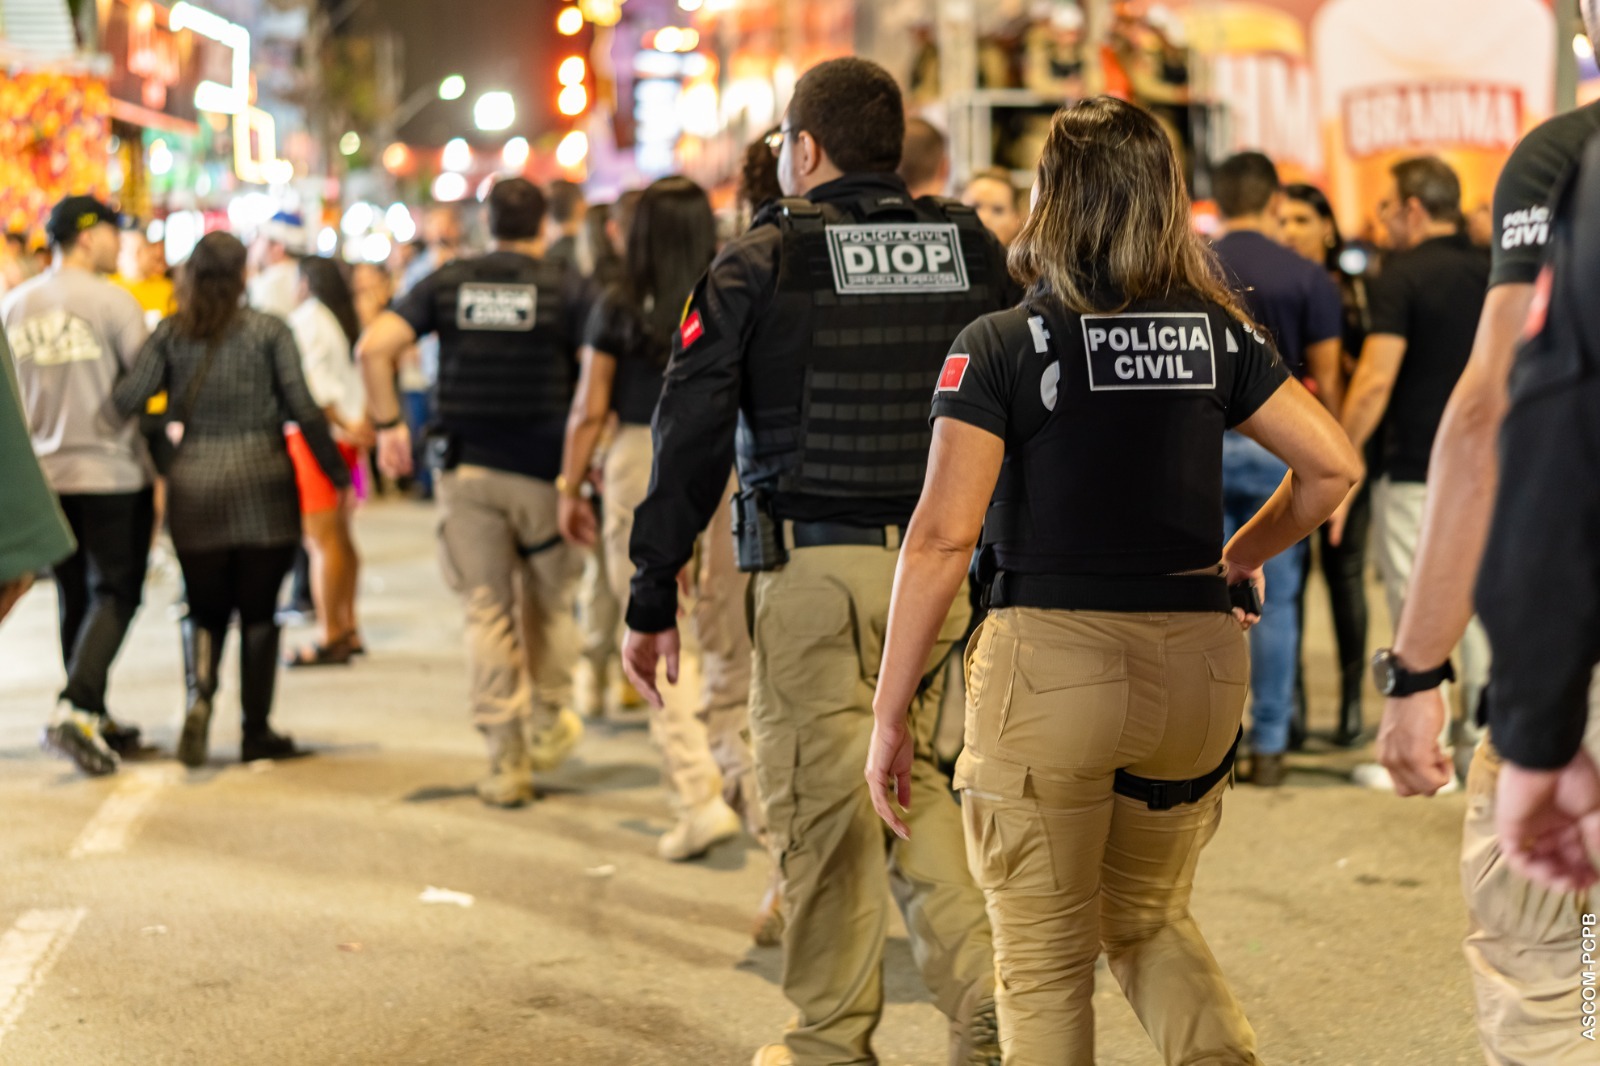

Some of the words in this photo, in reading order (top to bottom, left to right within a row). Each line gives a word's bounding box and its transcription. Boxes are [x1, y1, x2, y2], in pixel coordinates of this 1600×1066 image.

[1350, 87, 1519, 153] BRAHMA
[908, 229, 948, 243] CIVIL
[1501, 223, 1550, 250] CIVI
[842, 244, 951, 273] DIOP
[1088, 321, 1209, 351] POLÍCIA
[1114, 354, 1193, 379] CIVIL
